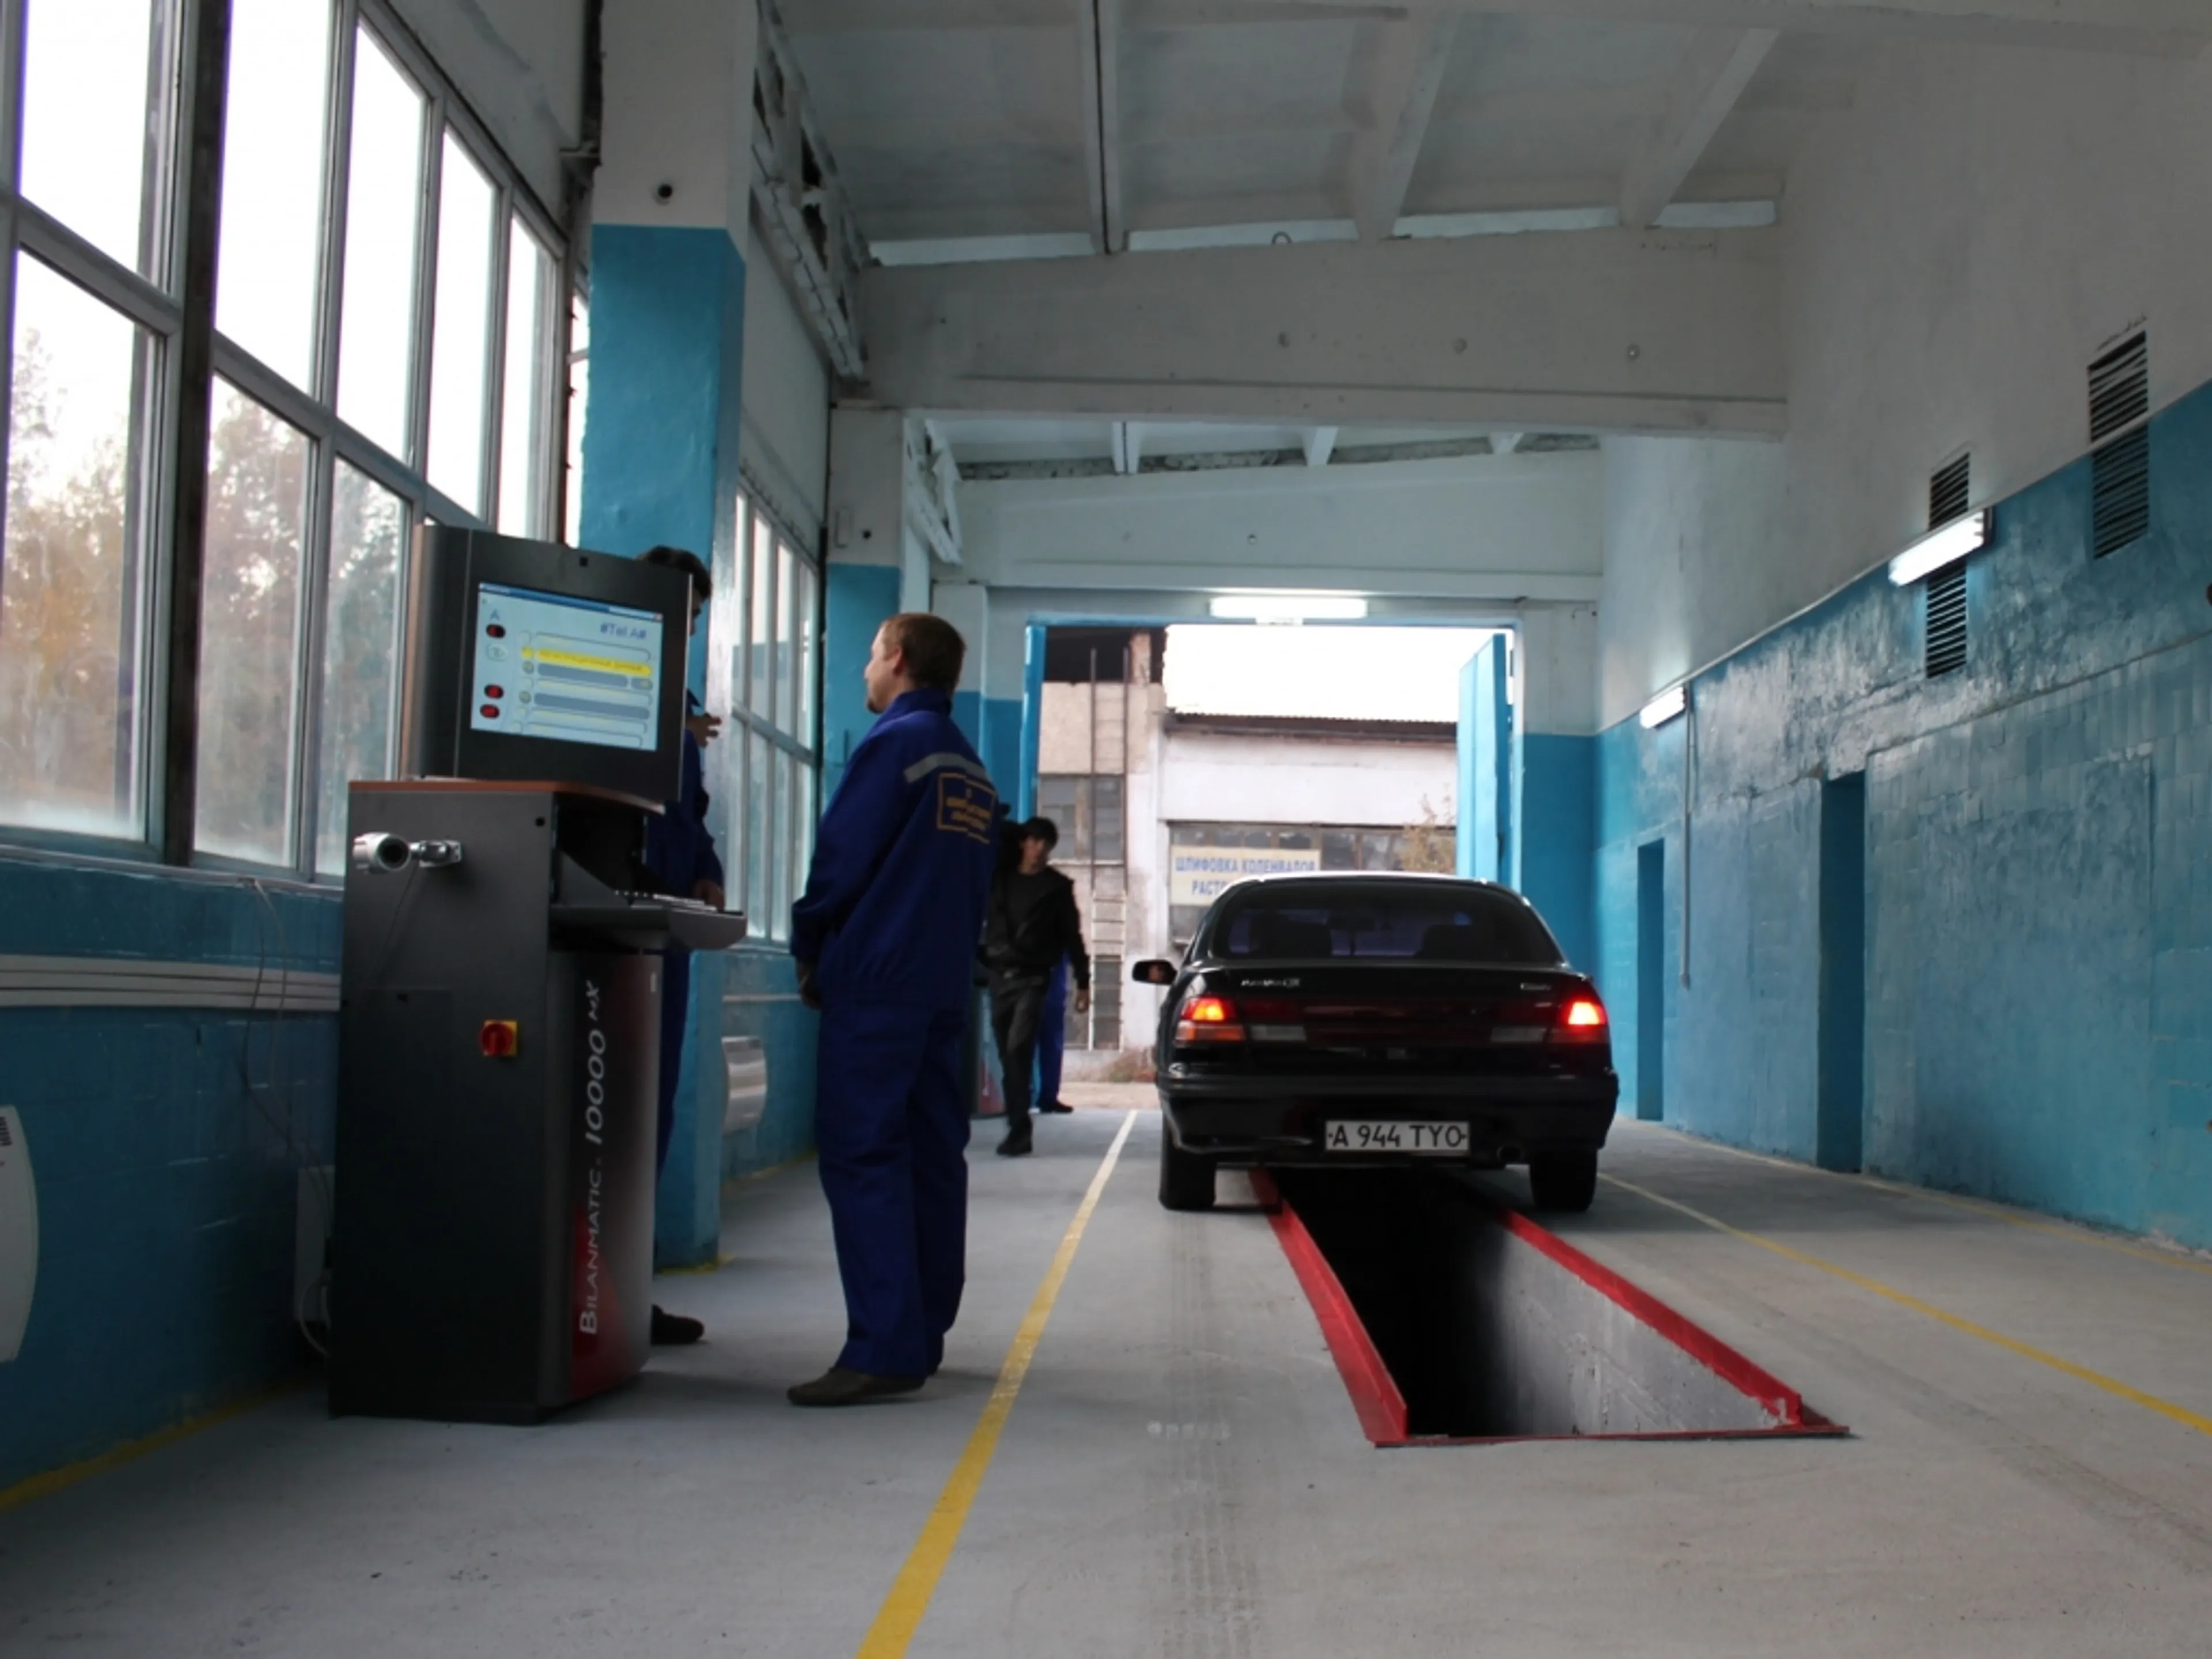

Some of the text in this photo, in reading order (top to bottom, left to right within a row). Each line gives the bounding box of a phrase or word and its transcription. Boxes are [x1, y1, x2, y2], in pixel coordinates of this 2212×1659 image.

[1176, 857, 1237, 872] ШЛИФОВКА
[585, 1029, 606, 1145] 10000
[1332, 1124, 1462, 1148] A 944 TYO
